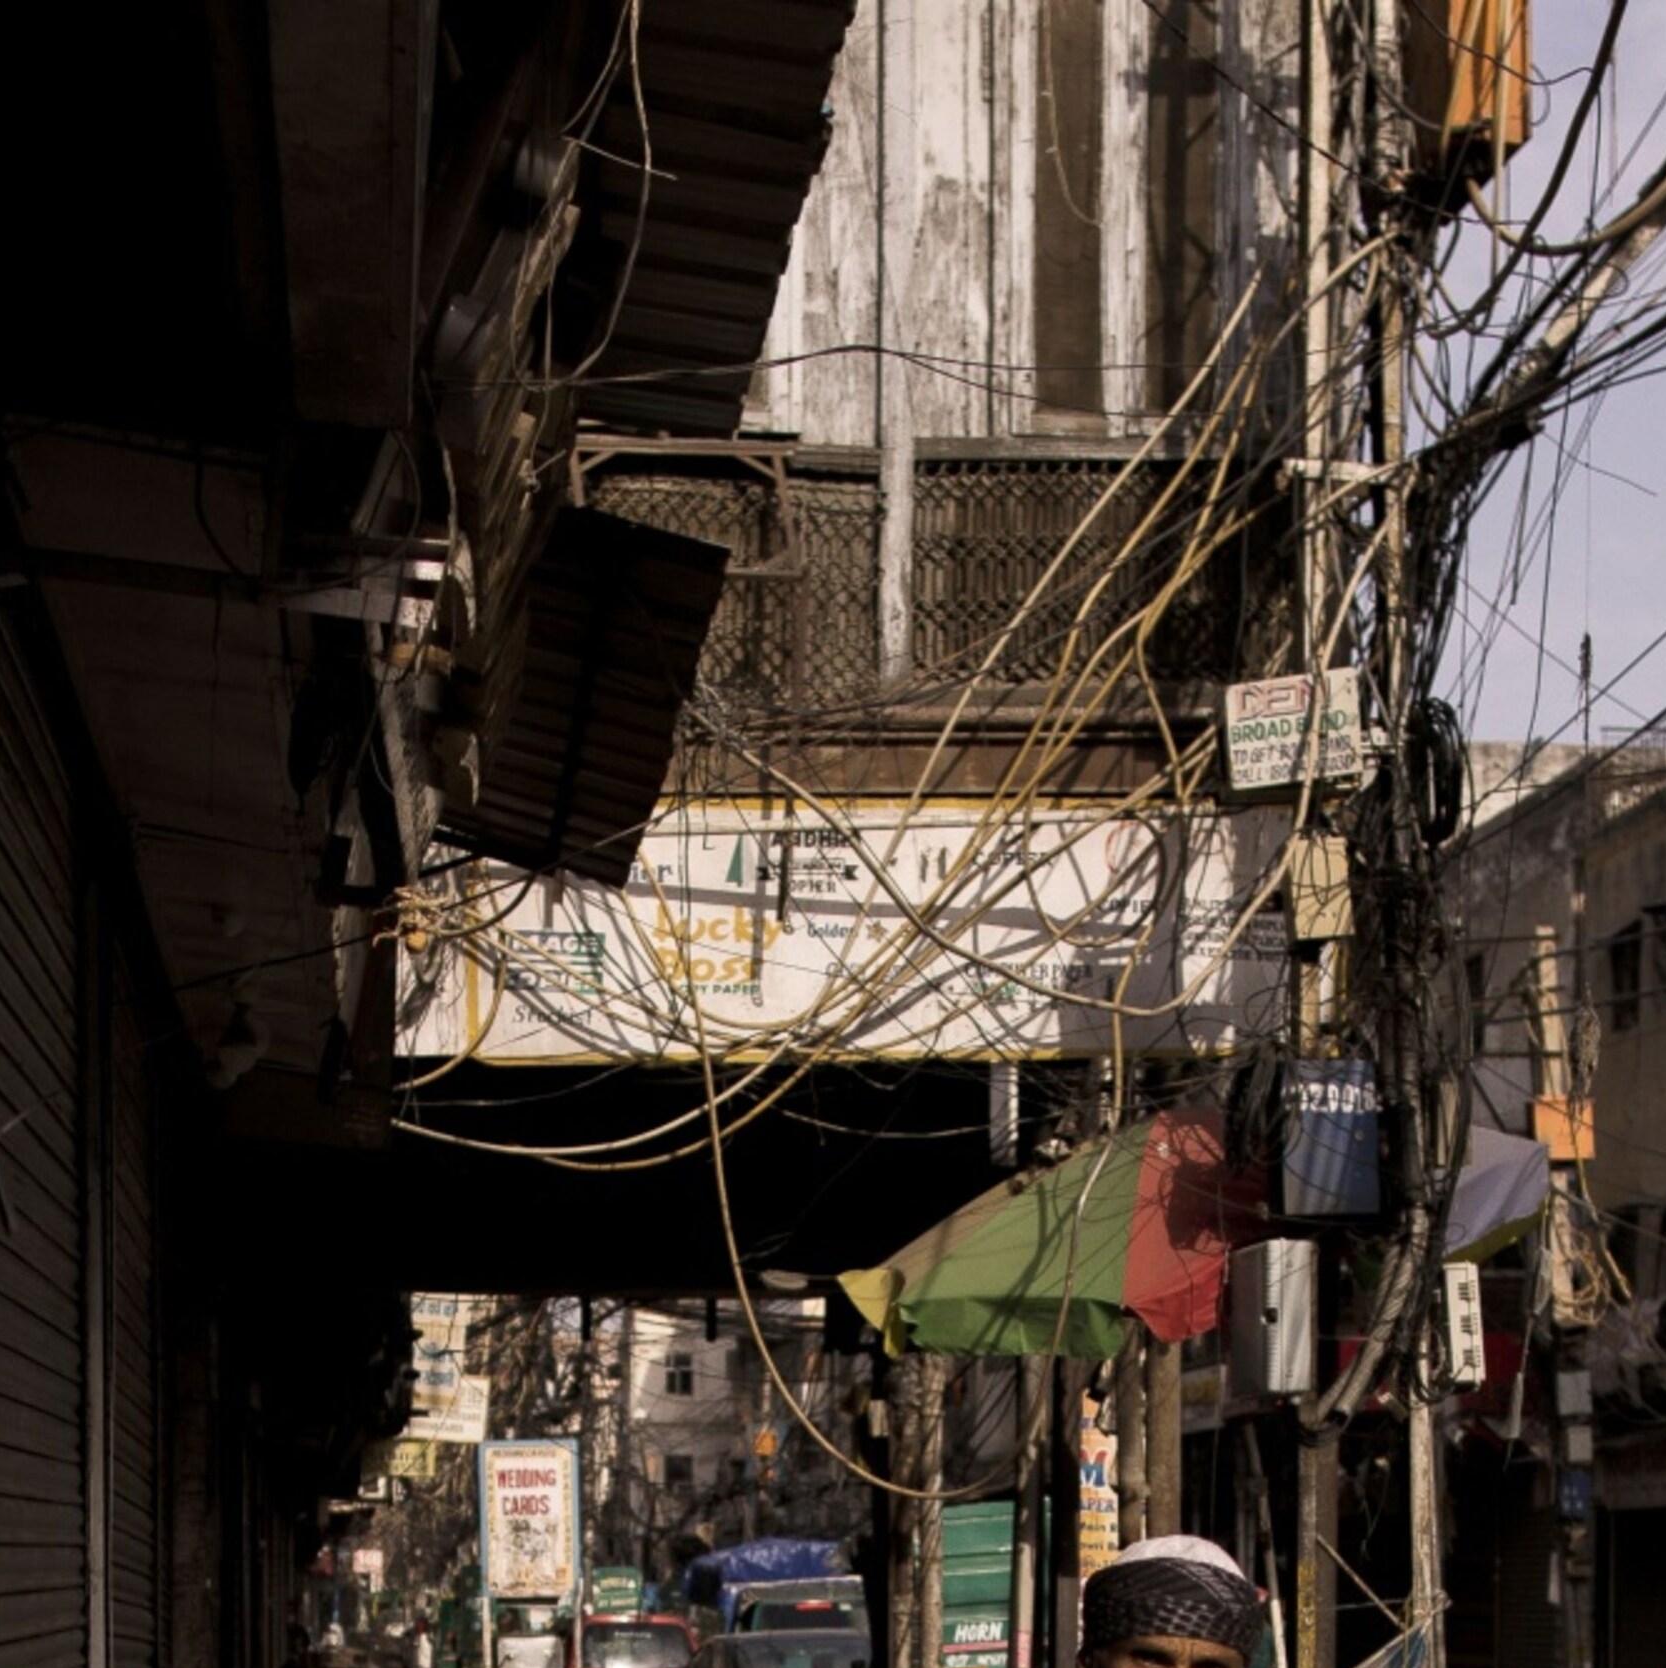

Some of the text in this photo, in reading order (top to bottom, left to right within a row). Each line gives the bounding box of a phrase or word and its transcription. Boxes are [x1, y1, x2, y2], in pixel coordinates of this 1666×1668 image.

[1231, 709, 1347, 744] BROAD BND
[497, 1468, 557, 1489] WEDDING
[502, 1495, 550, 1516] CARDS
[954, 1621, 1003, 1643] HORN
